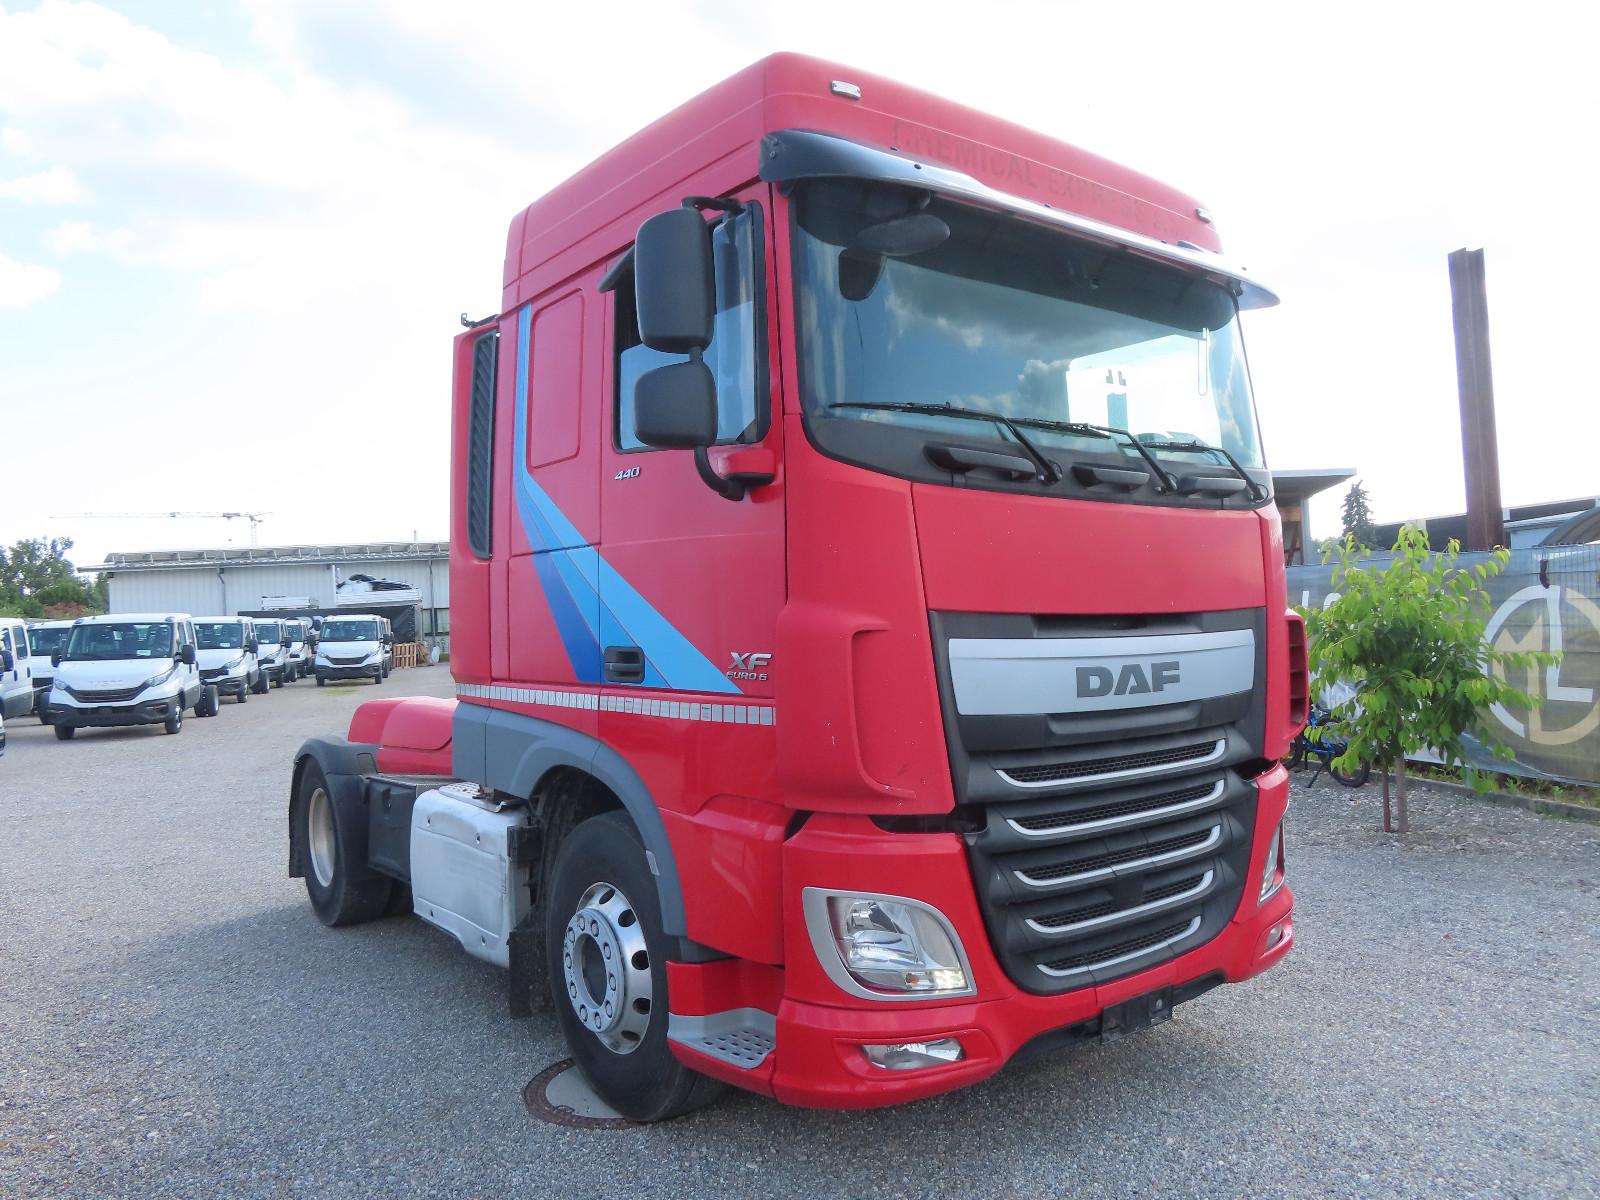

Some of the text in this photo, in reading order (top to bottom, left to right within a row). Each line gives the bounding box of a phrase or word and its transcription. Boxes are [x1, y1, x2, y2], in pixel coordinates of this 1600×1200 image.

[614, 466, 641, 481] 440
[728, 652, 772, 671] XF
[726, 671, 769, 682] EURO 6
[1075, 660, 1181, 699] DAF
